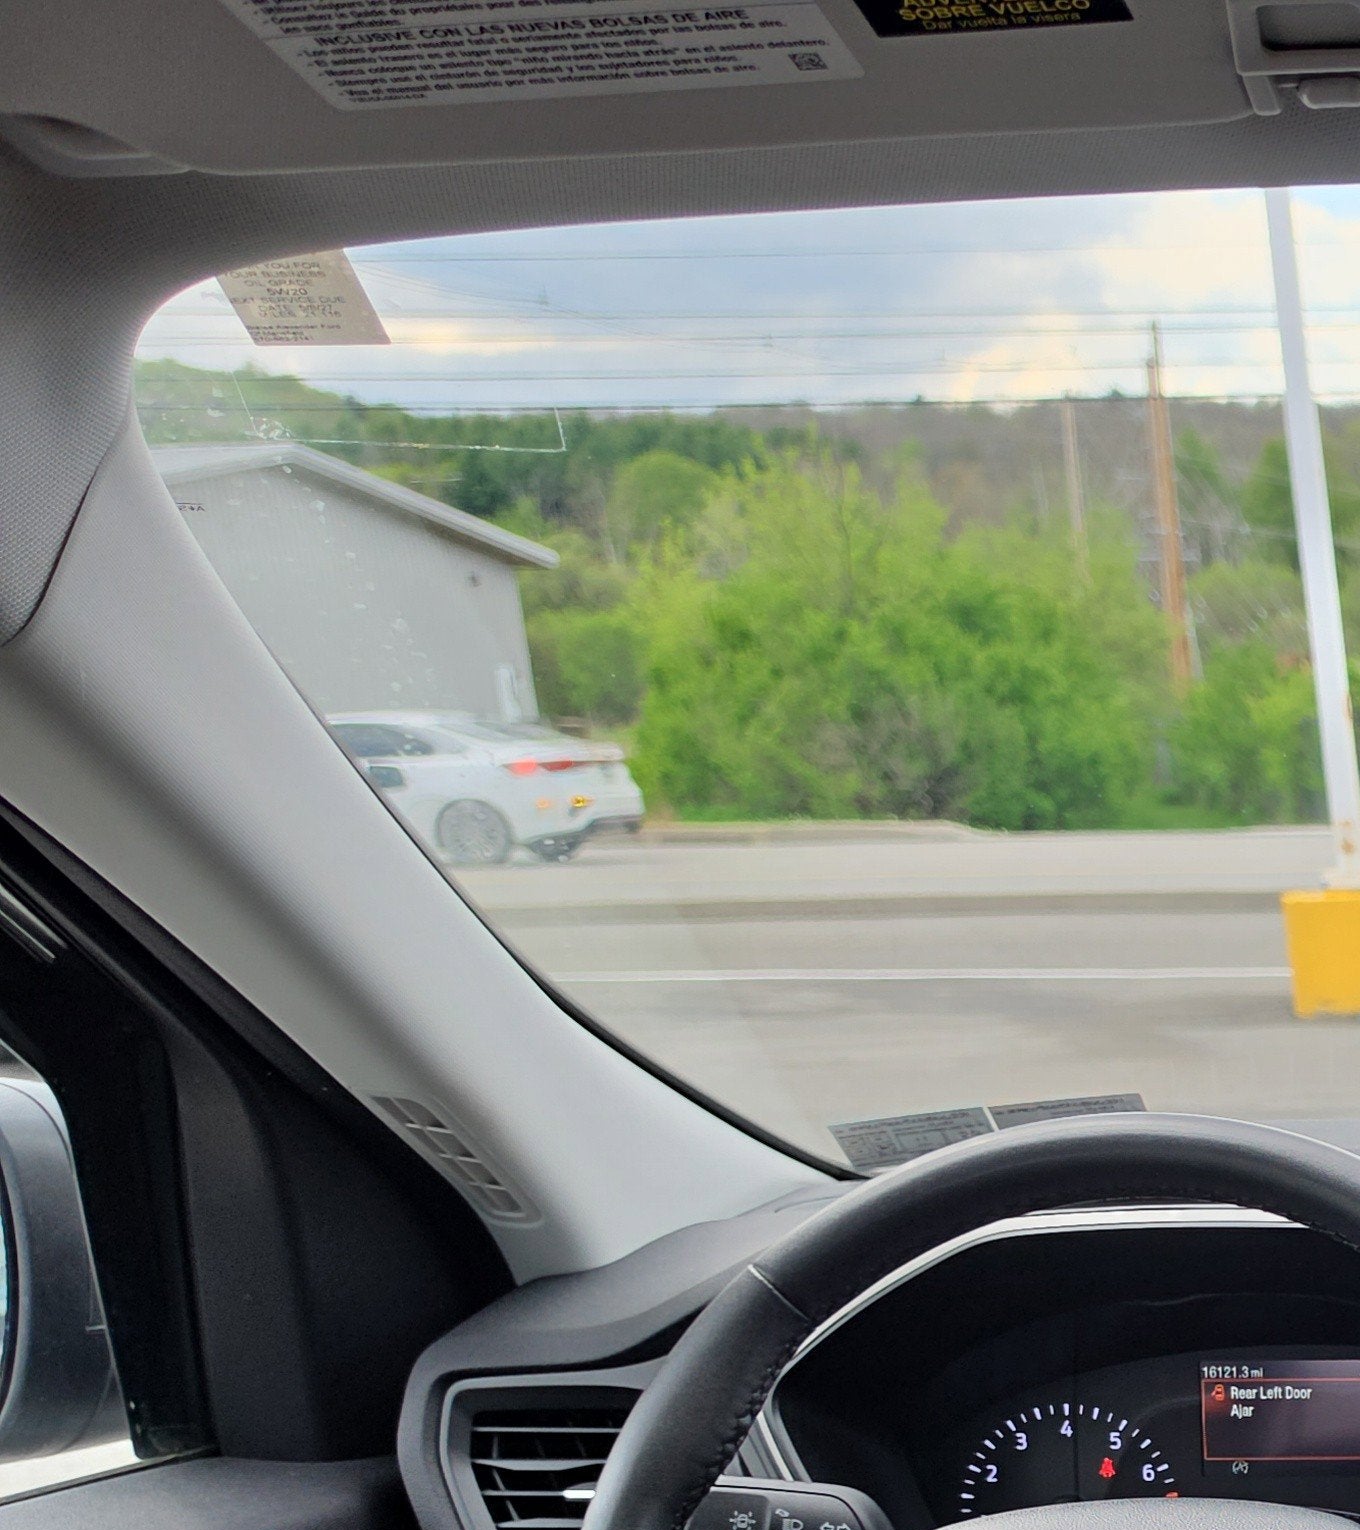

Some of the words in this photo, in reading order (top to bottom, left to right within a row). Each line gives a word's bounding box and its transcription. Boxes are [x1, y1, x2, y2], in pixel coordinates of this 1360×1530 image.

[899, 3, 986, 21] SOBRE
[988, 0, 1090, 16] VUELCO
[316, 30, 416, 46] INCLUSIVE
[418, 27, 461, 39] CON
[464, 24, 503, 36] LAS
[508, 18, 585, 33] NUEVAS
[589, 13, 668, 28] BOLSAS
[672, 11, 699, 22] DE
[704, 8, 750, 20] AIRE
[1201, 1366, 1250, 1378] 16121.3
[1250, 1367, 1264, 1378] mi
[1230, 1385, 1258, 1400] Rear
[1259, 1385, 1283, 1400] Left
[1284, 1385, 1313, 1400] Door
[1230, 1404, 1255, 1419] Ajar
[1060, 1419, 1074, 1438] 4
[1014, 1432, 1028, 1450] 3
[1109, 1431, 1122, 1450] 5
[985, 1464, 998, 1482] 2
[1142, 1463, 1155, 1482] 6
